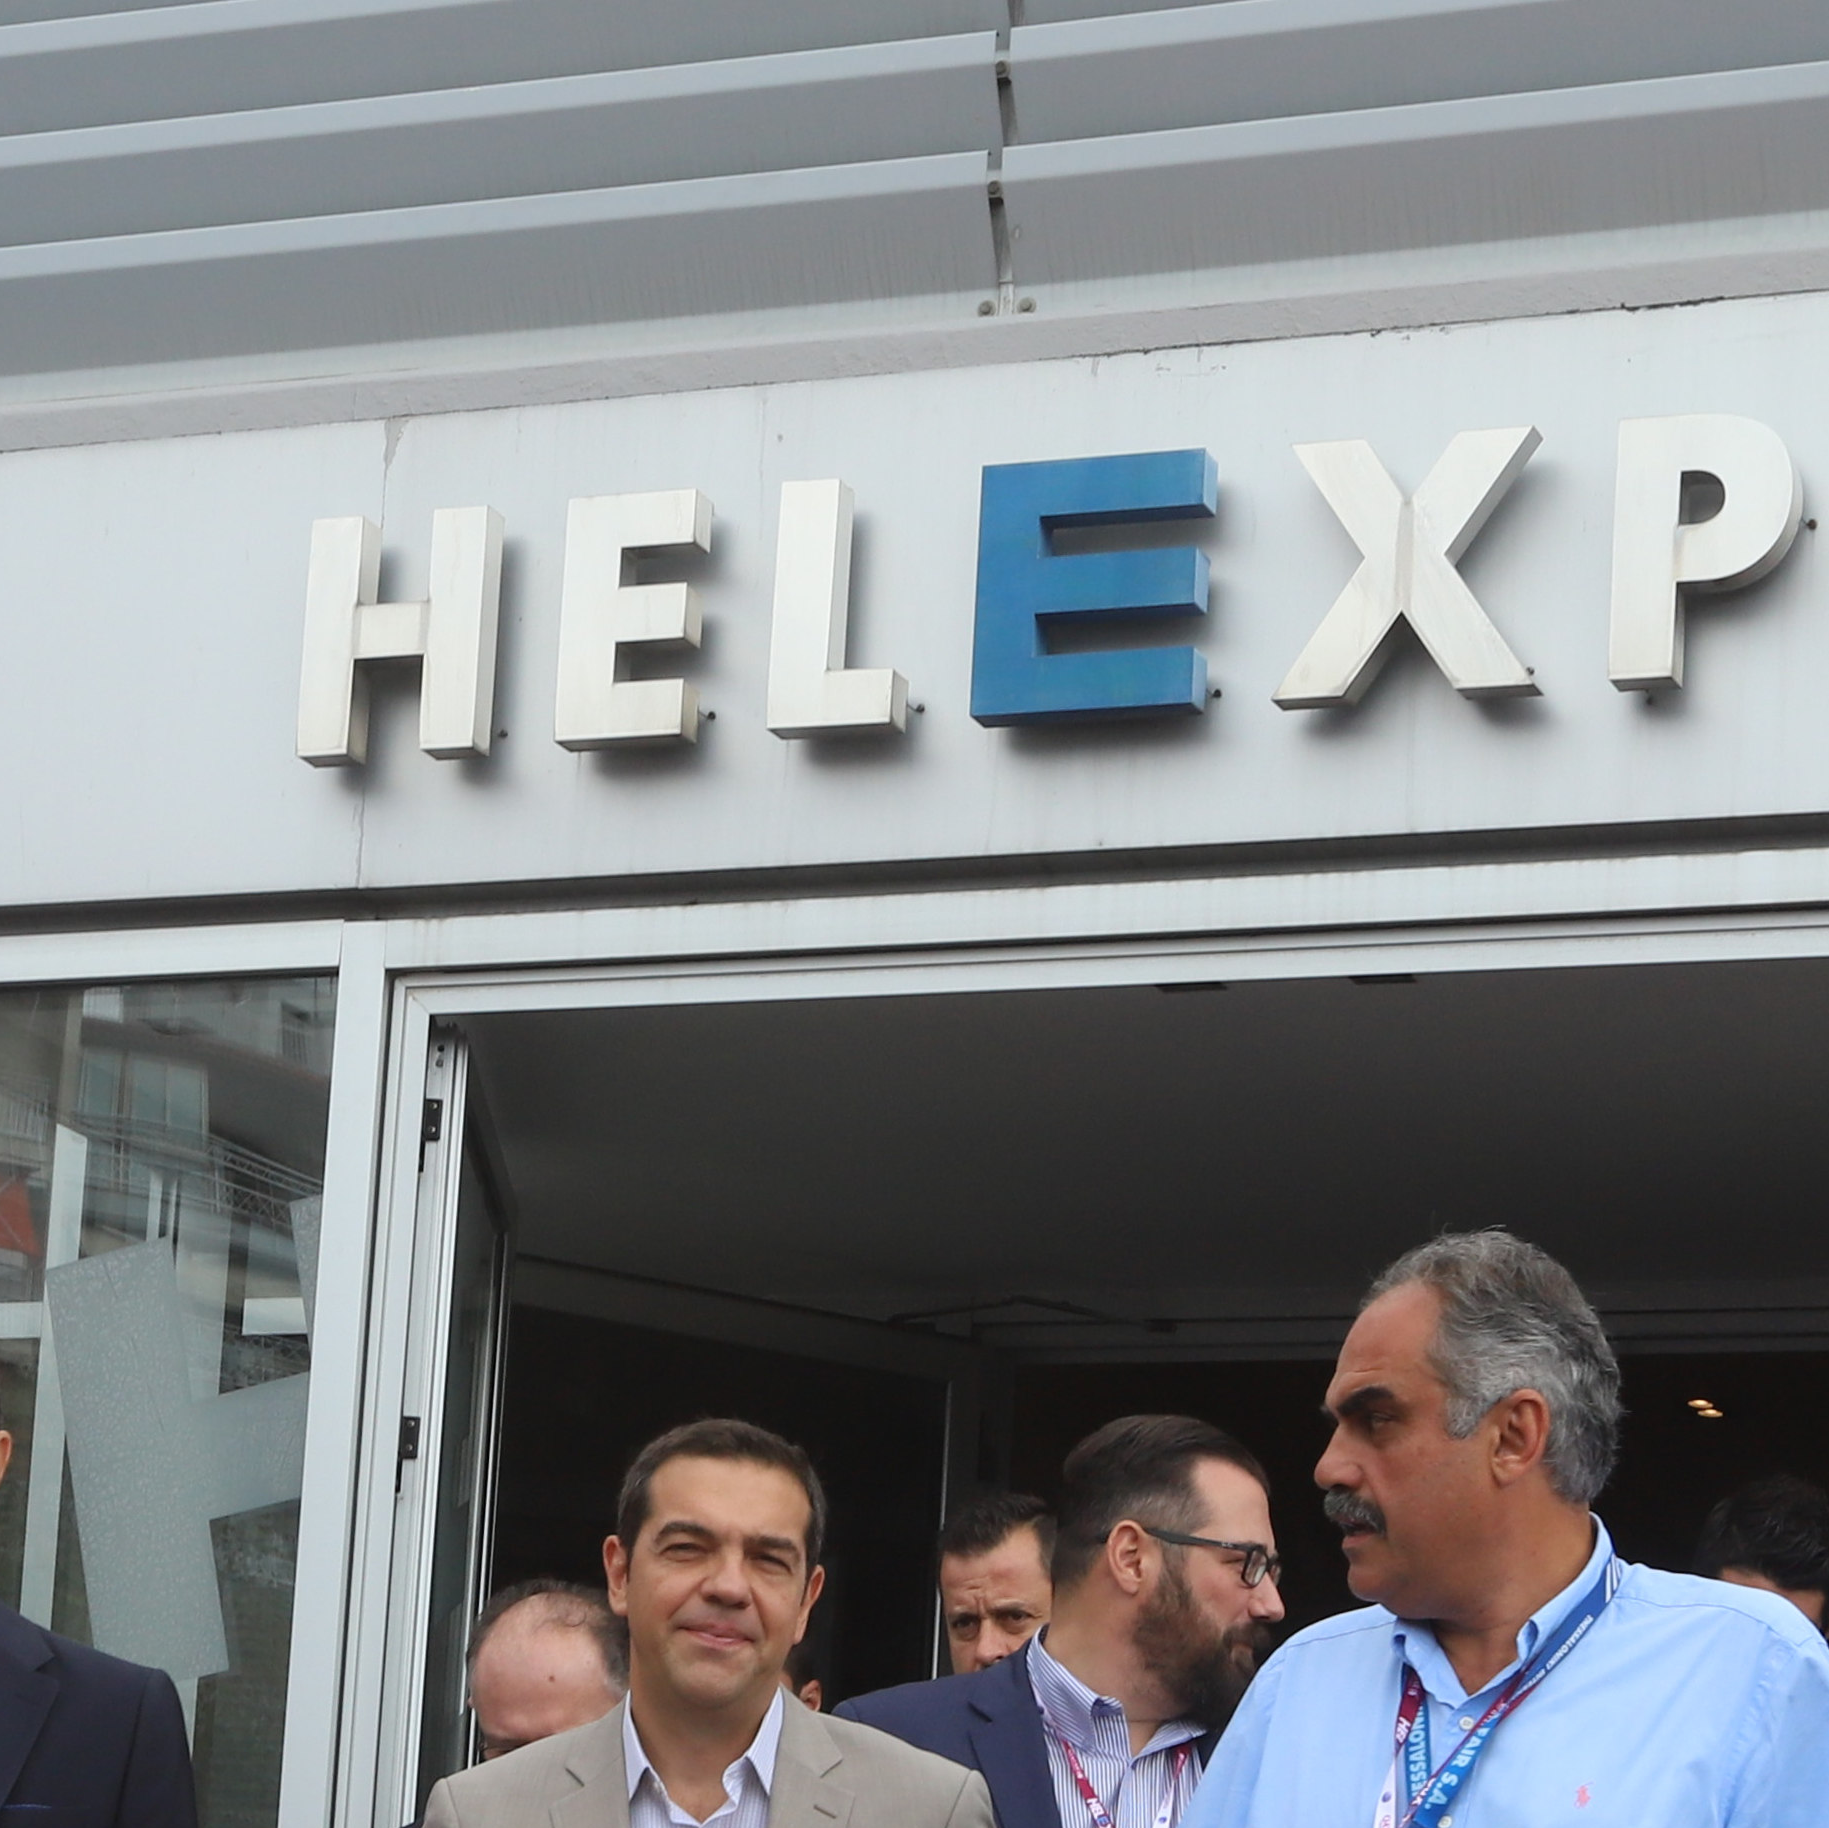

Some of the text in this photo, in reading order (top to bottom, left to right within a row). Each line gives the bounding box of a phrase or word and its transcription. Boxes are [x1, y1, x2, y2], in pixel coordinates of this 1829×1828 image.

[1545, 1614, 1594, 1671] THESSALONIKI
[1451, 1726, 1491, 1768] FAIR
[1424, 1771, 1459, 1810] S.A.
